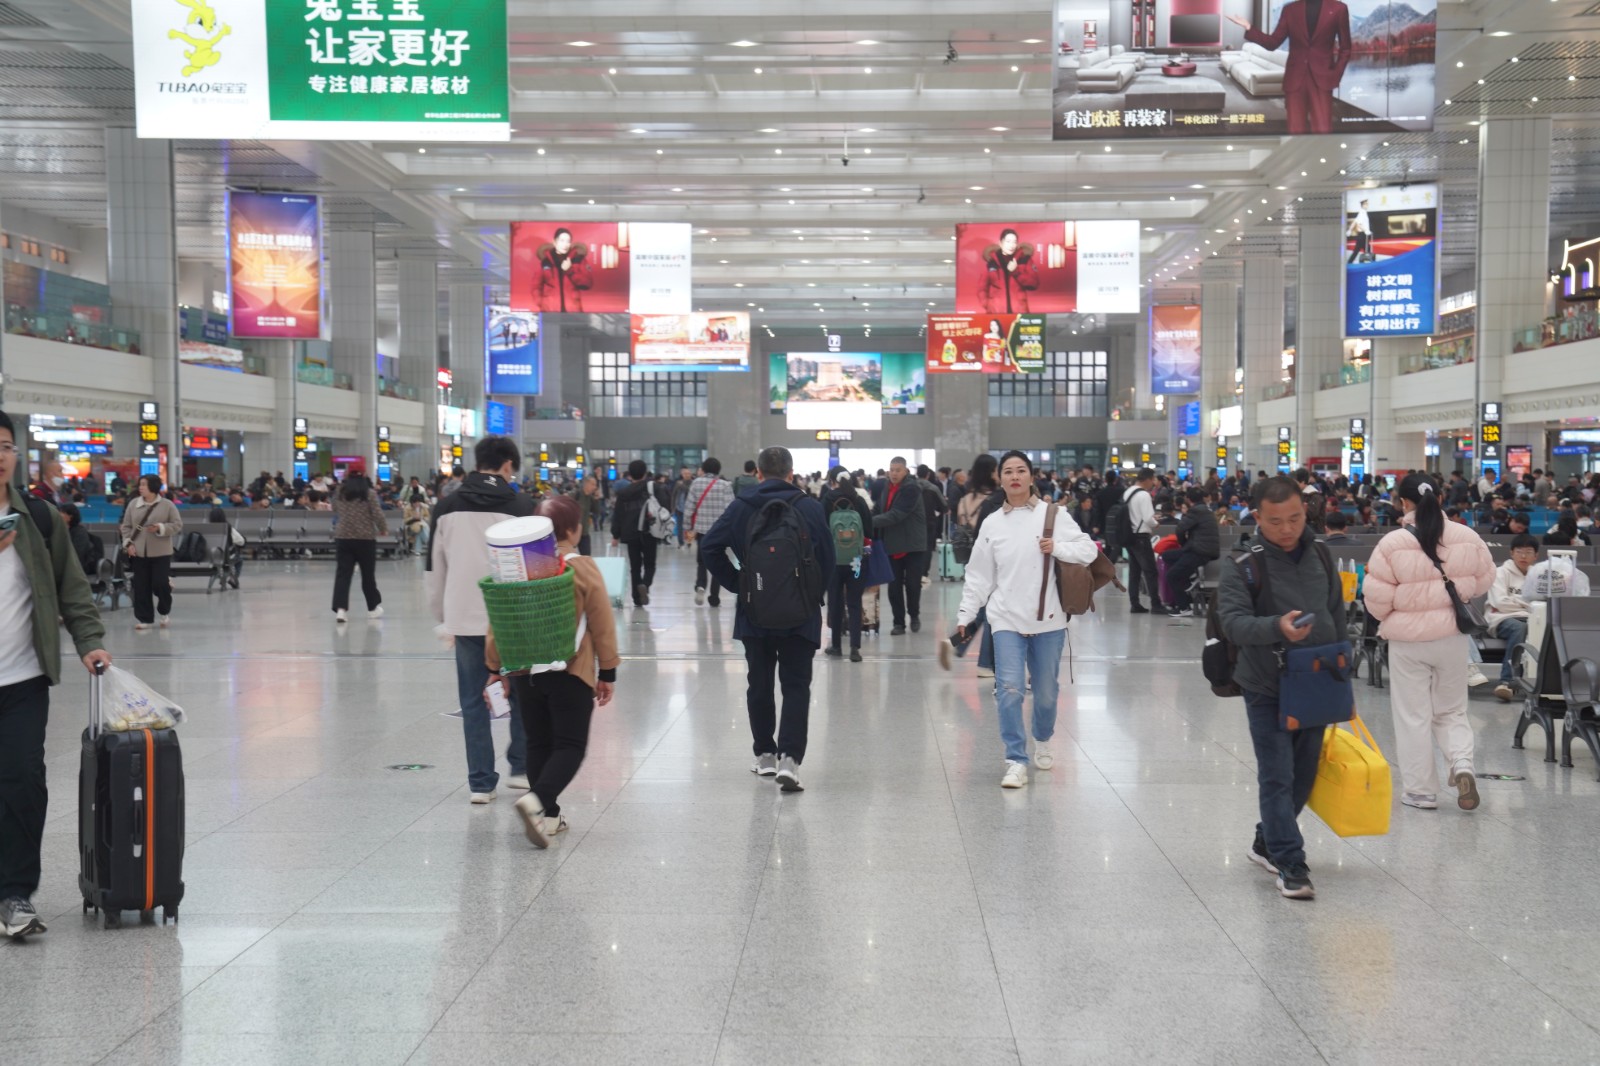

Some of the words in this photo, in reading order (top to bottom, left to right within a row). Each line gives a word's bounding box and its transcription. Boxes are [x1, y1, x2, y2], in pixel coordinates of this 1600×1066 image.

[305, 27, 470, 67] 让家更好
[308, 75, 470, 95] 专注健康家居板材
[1063, 110, 1121, 128] 看过欧派
[1123, 108, 1167, 127] 再装家
[1366, 274, 1413, 287] 讲文明
[1366, 288, 1413, 302] 树新风
[1359, 303, 1421, 317] 有序乘车
[1359, 317, 1421, 331] 文明出行
[1483, 425, 1500, 434] 12A
[1483, 433, 1500, 442] 13A
